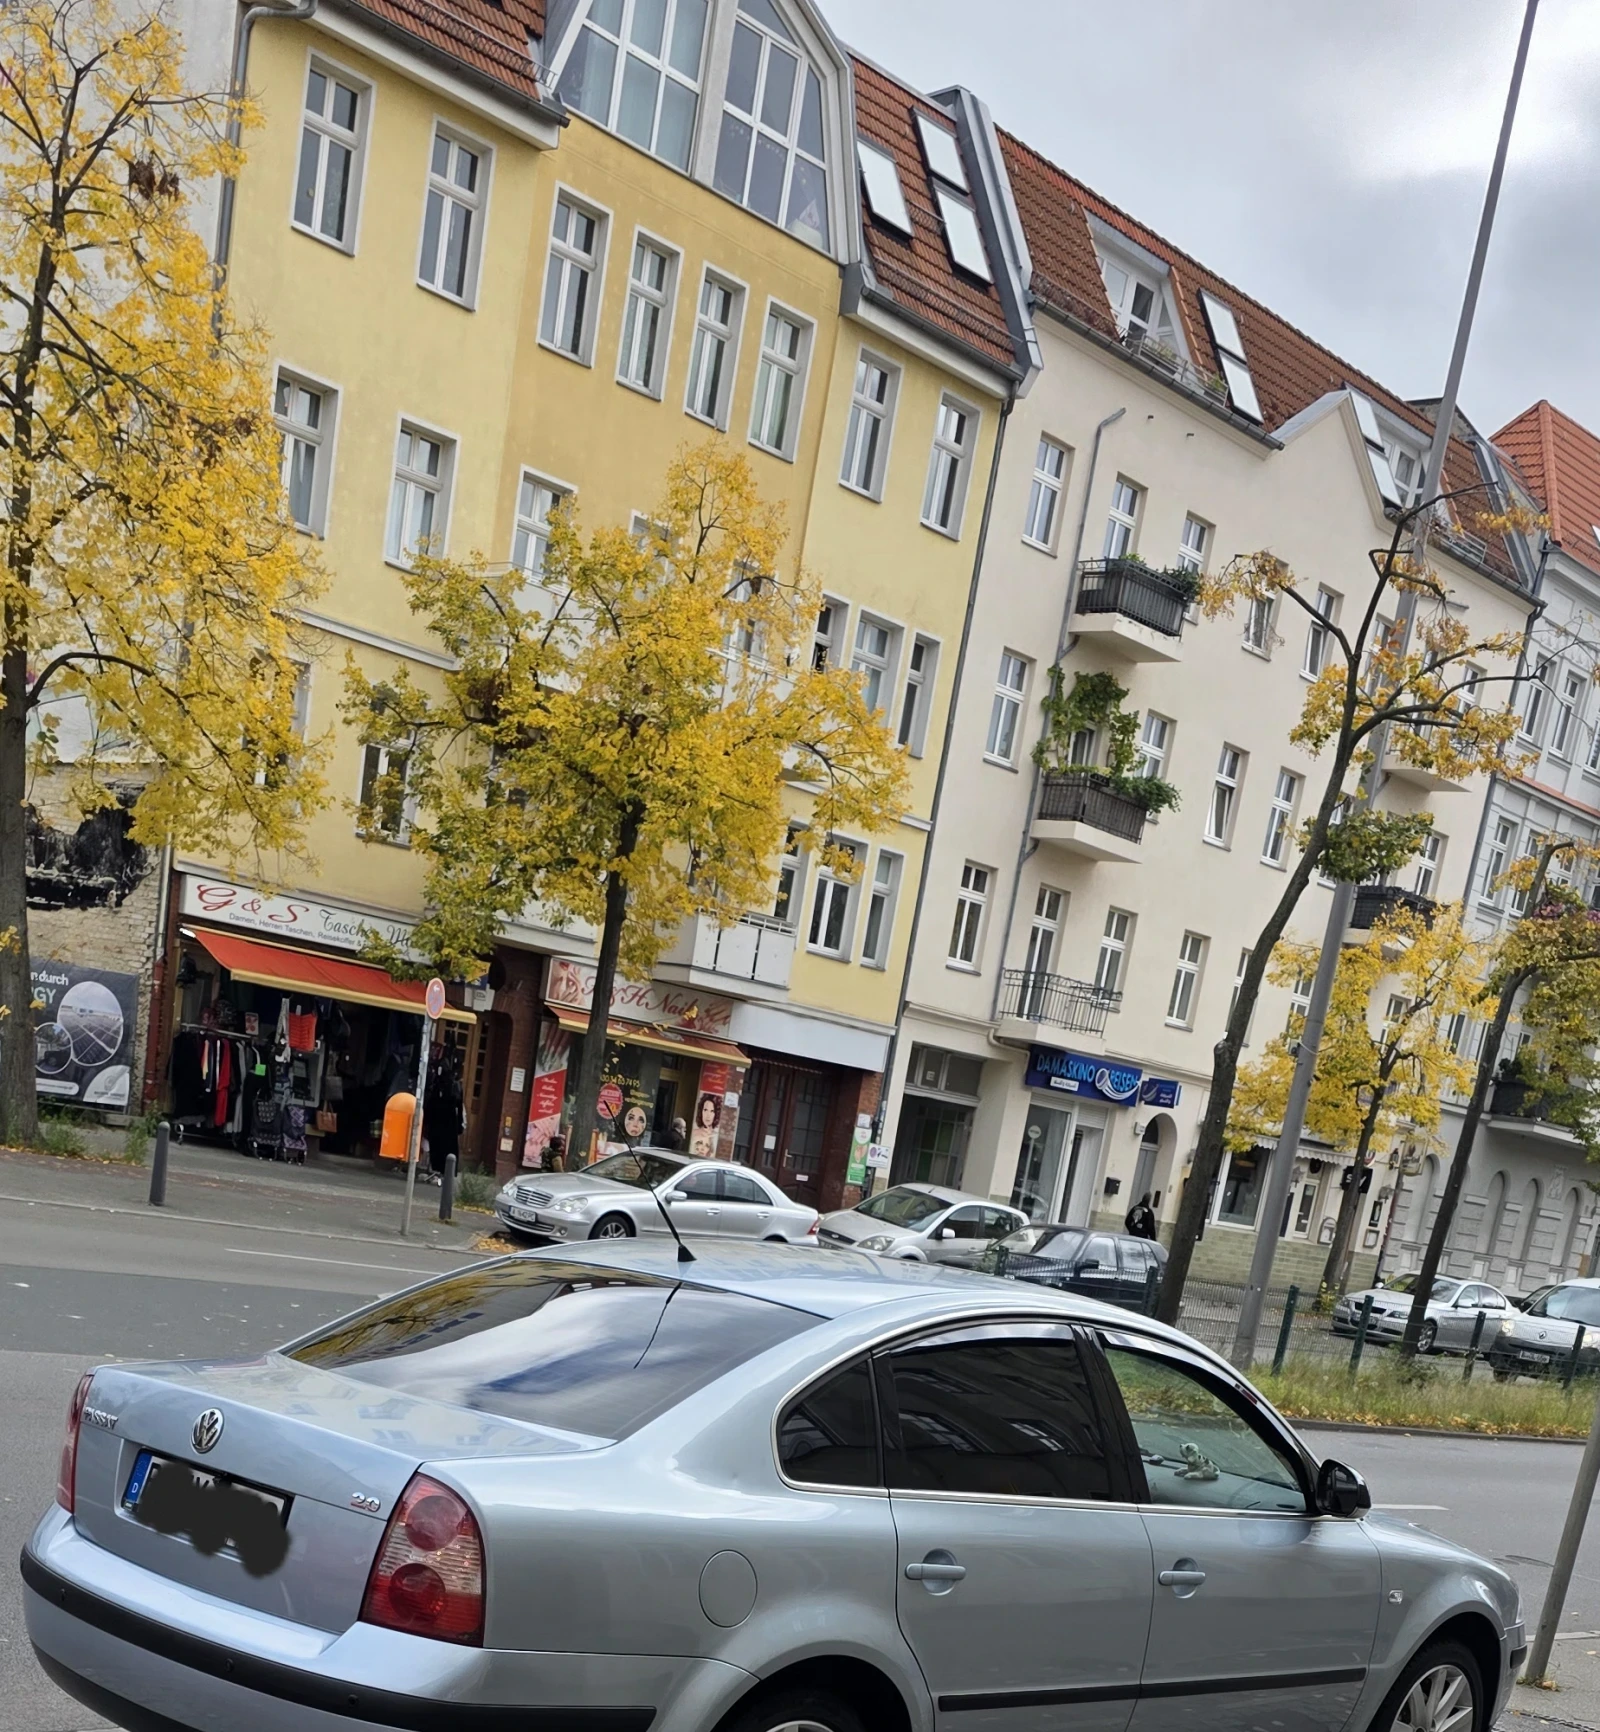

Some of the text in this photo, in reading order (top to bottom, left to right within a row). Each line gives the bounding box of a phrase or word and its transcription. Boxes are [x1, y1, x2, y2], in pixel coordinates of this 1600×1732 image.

[196, 884, 310, 923] G & S
[319, 909, 372, 939] Tasch
[645, 993, 698, 1017] Nail
[1036, 1054, 1095, 1083] DAMASKINO
[131, 1483, 139, 1493] D
